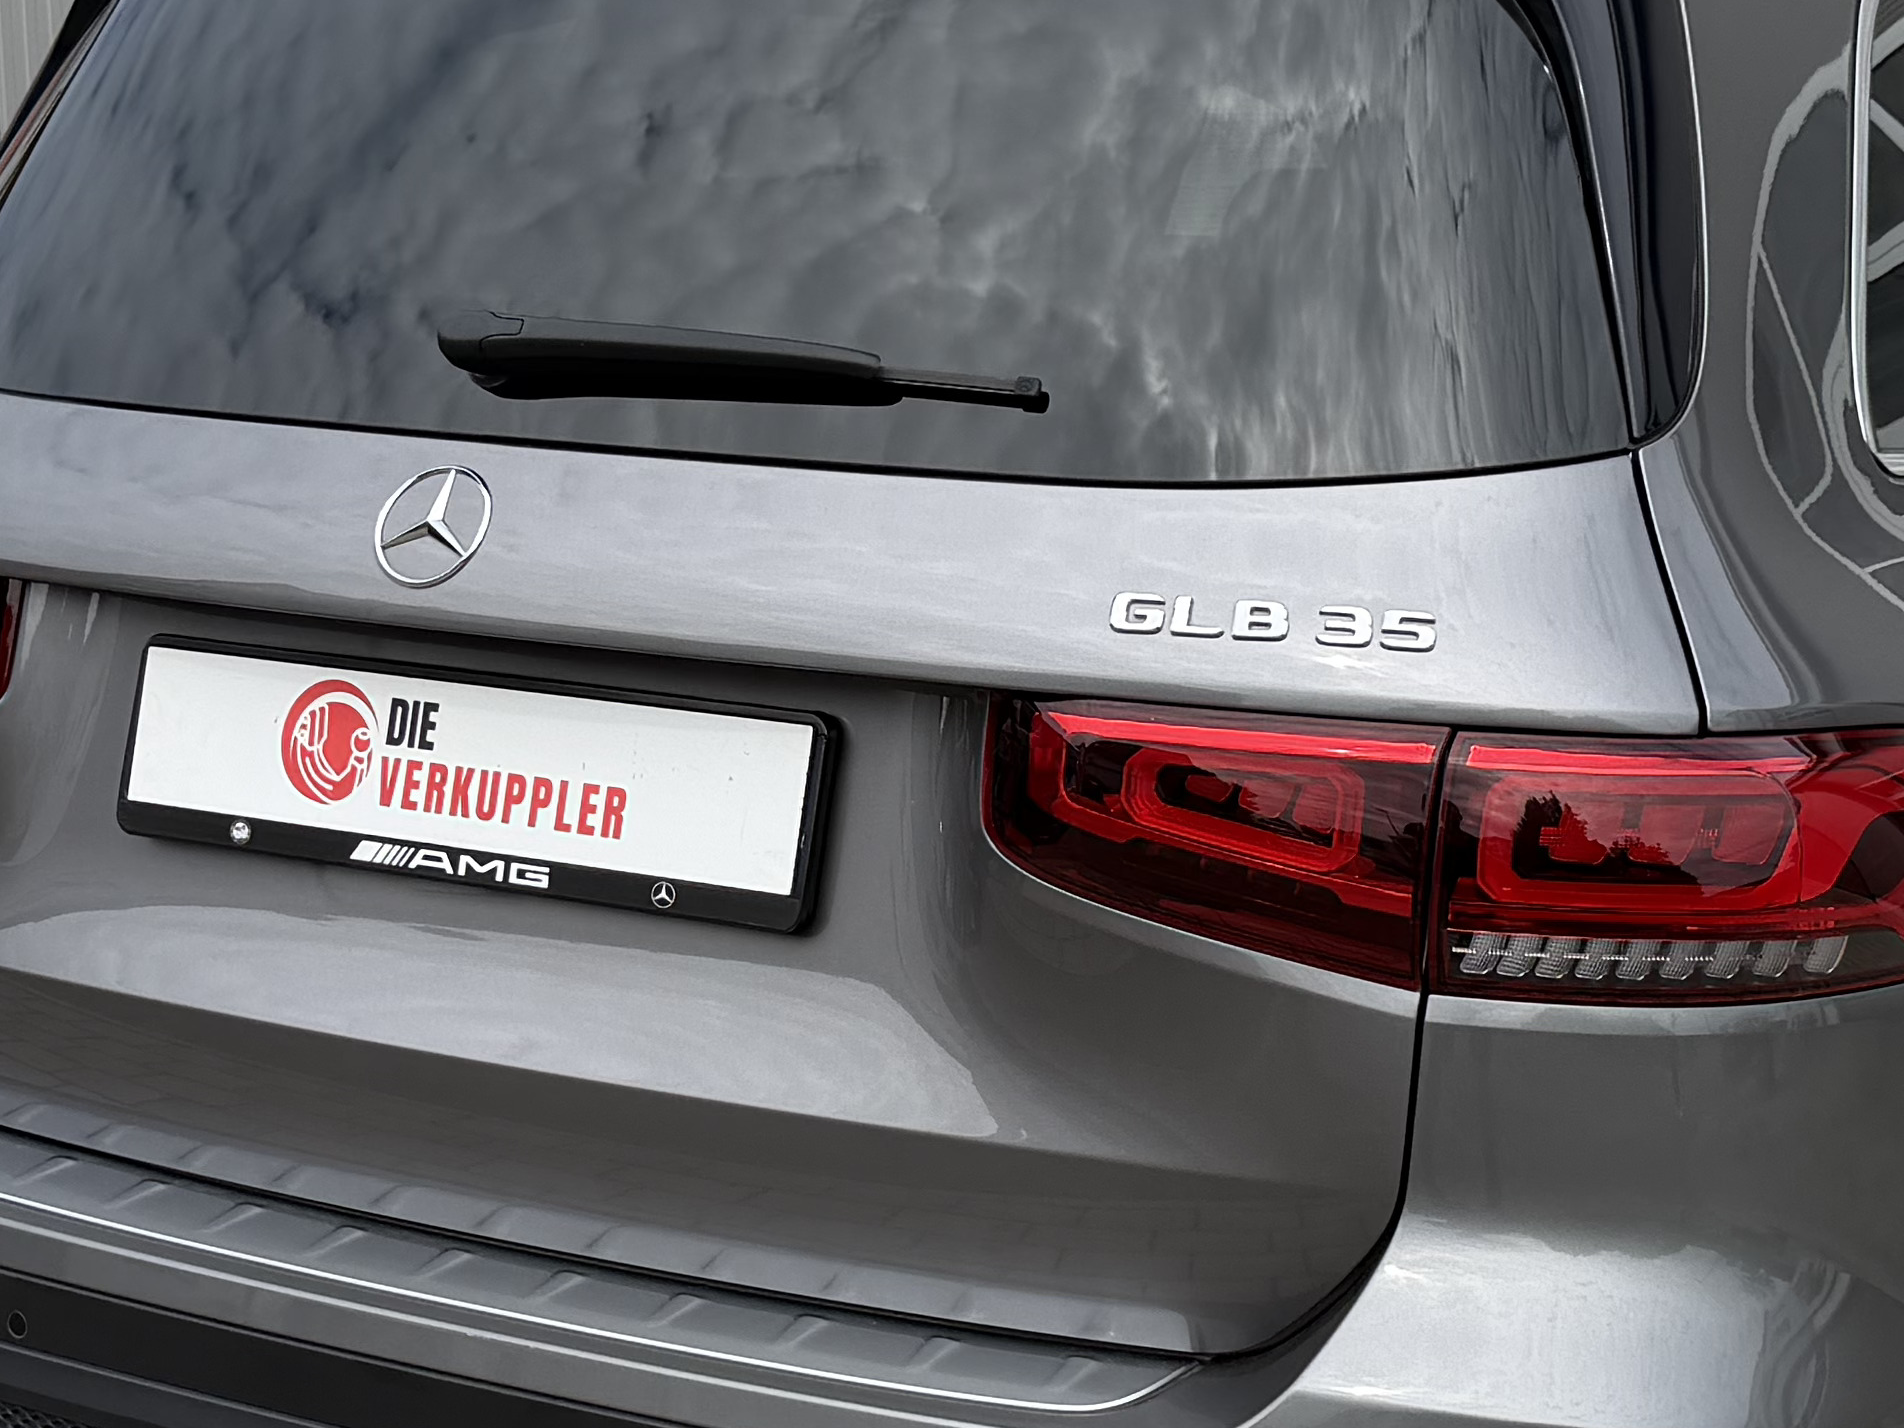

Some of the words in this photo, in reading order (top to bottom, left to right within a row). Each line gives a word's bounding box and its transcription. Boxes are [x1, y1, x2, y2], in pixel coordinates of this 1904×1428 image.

[1109, 591, 1290, 642] GLB
[1315, 604, 1438, 652] 35
[386, 698, 440, 751] DIE
[379, 756, 628, 840] VERKUPPLER
[409, 847, 550, 889] AMG
